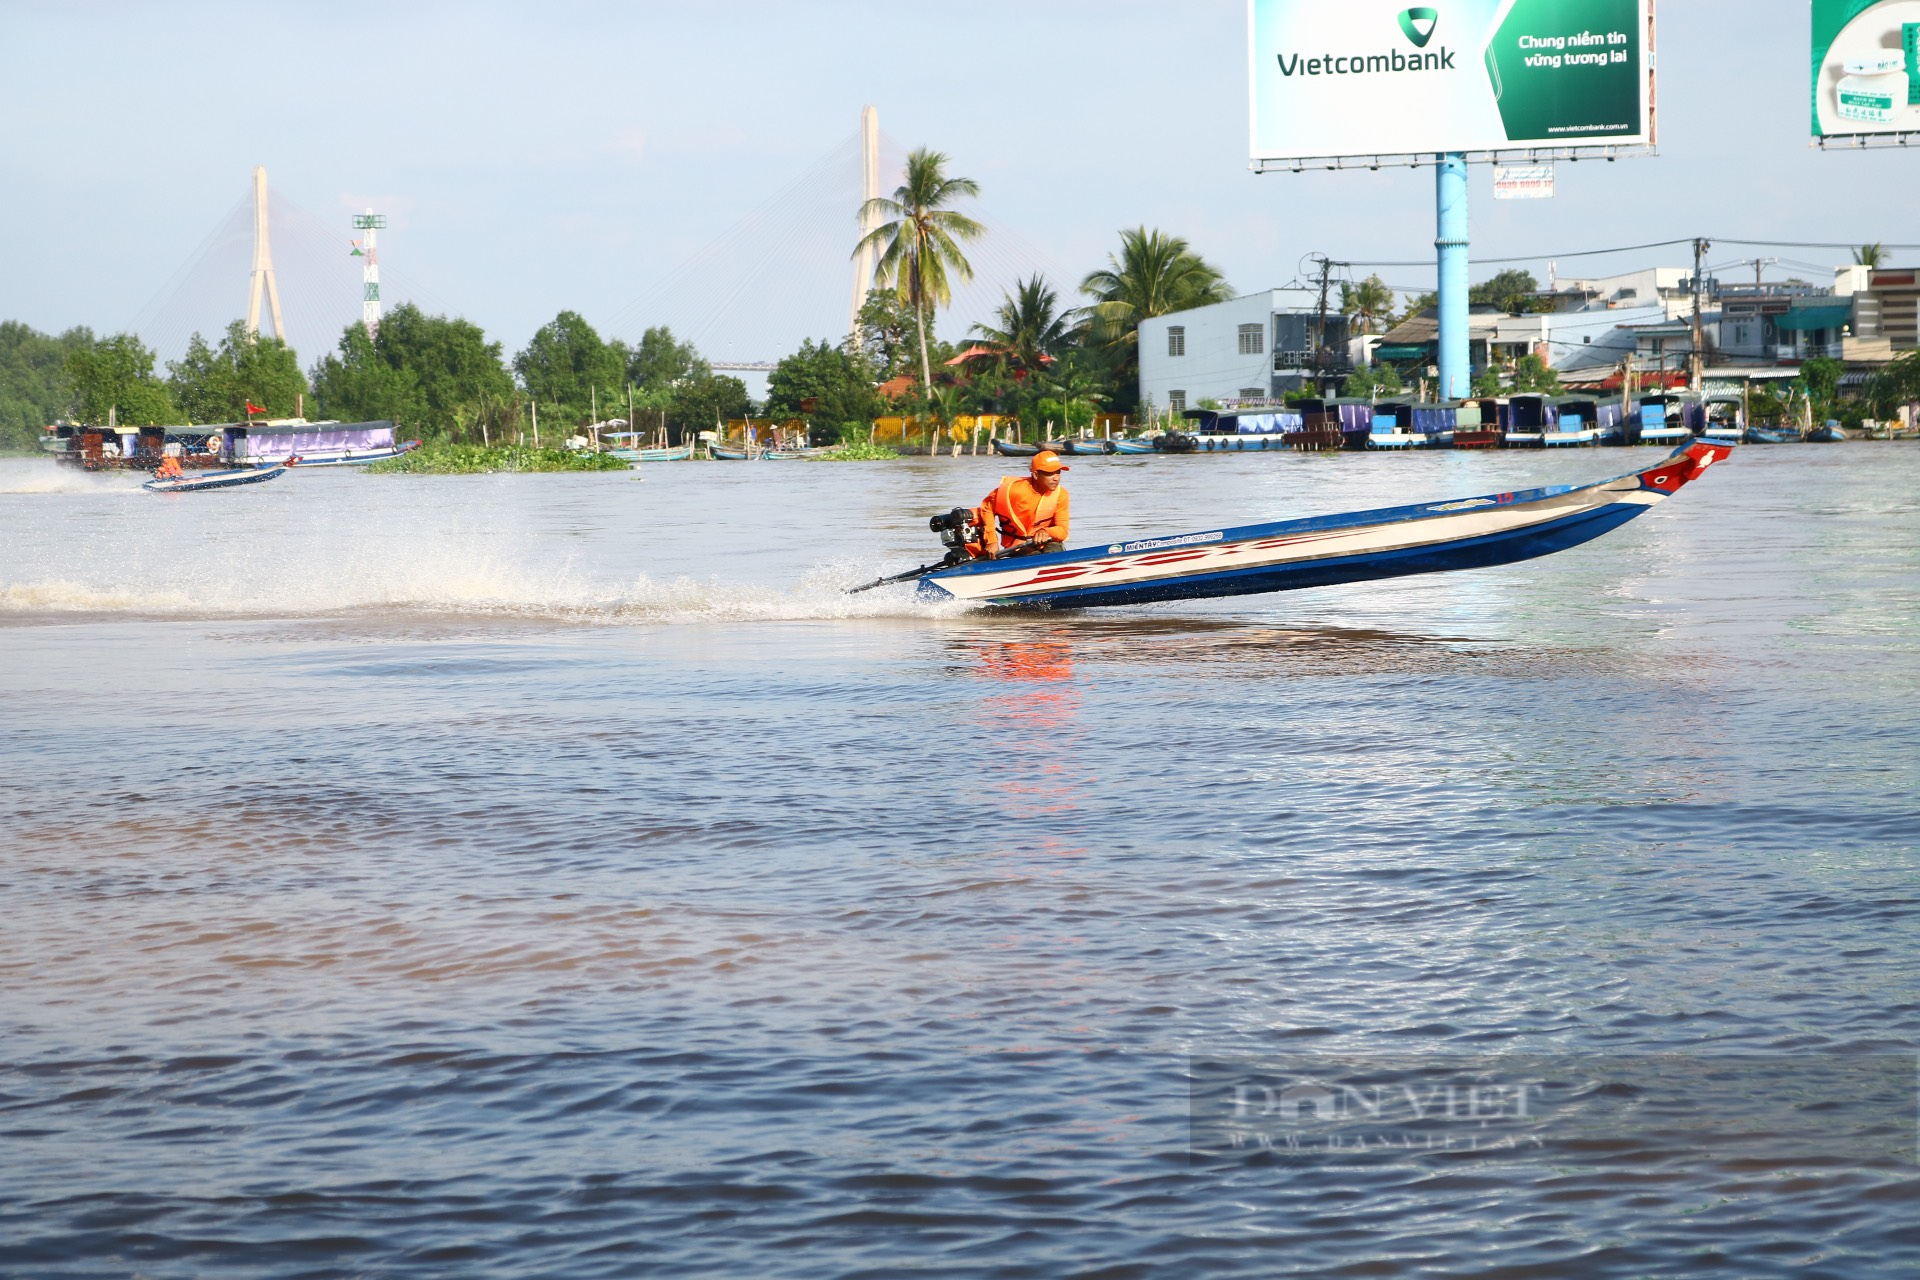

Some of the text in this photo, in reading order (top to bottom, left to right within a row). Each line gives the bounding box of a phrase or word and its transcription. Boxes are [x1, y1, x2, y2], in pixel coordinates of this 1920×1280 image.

[1519, 30, 1627, 50] Chung niềm tin
[1277, 46, 1456, 77] Vietcombank
[1525, 50, 1627, 68] vững tương lai
[1548, 123, 1628, 133] www.vietcombank.com.vn
